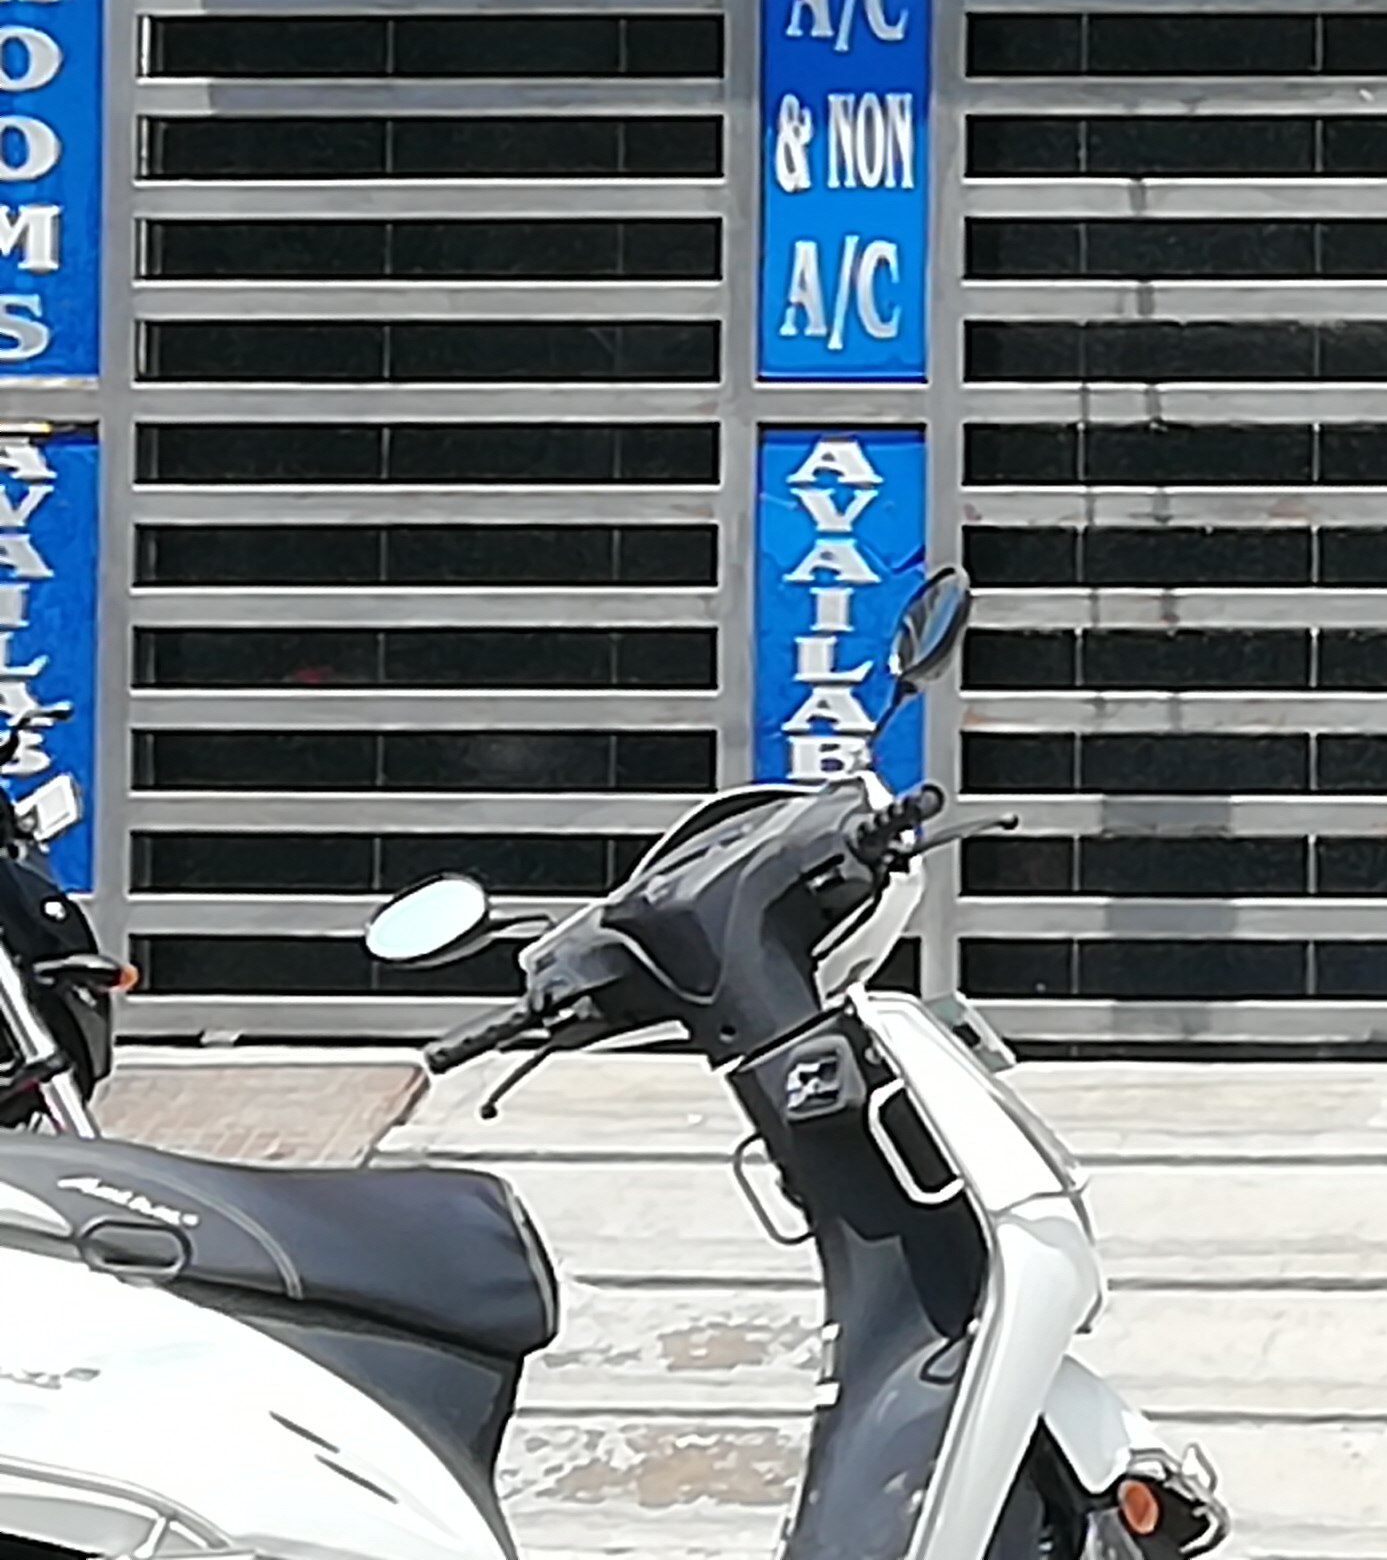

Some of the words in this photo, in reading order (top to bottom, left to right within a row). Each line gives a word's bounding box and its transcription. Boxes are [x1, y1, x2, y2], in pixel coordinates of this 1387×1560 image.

[775, 93, 813, 193] &
[827, 92, 914, 190] NON
[779, 235, 901, 350] A/C
[781, 437, 884, 781] AVAILAB
